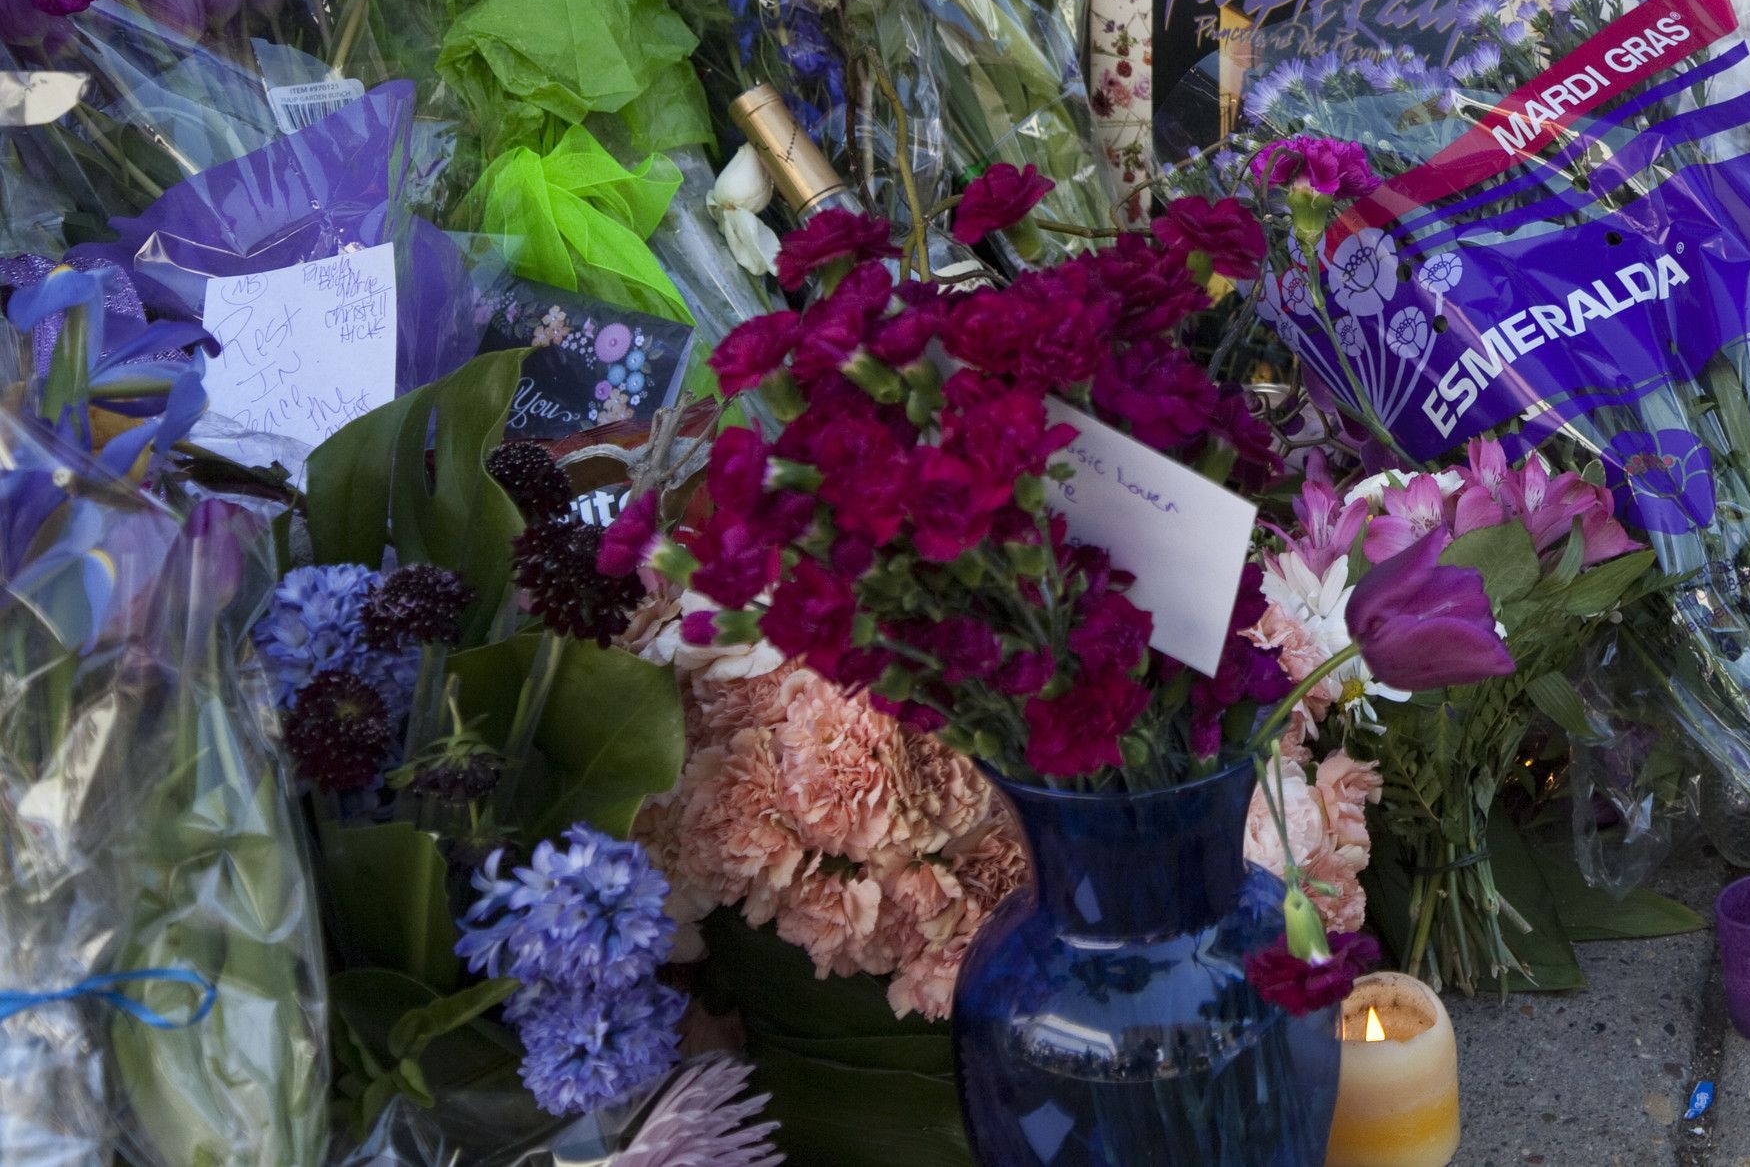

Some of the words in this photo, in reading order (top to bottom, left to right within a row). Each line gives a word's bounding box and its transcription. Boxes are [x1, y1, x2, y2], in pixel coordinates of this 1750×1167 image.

[1490, 64, 1609, 157] MARDI
[213, 304, 301, 369] Rest
[507, 376, 581, 429] You
[1066, 445, 1105, 475] usic
